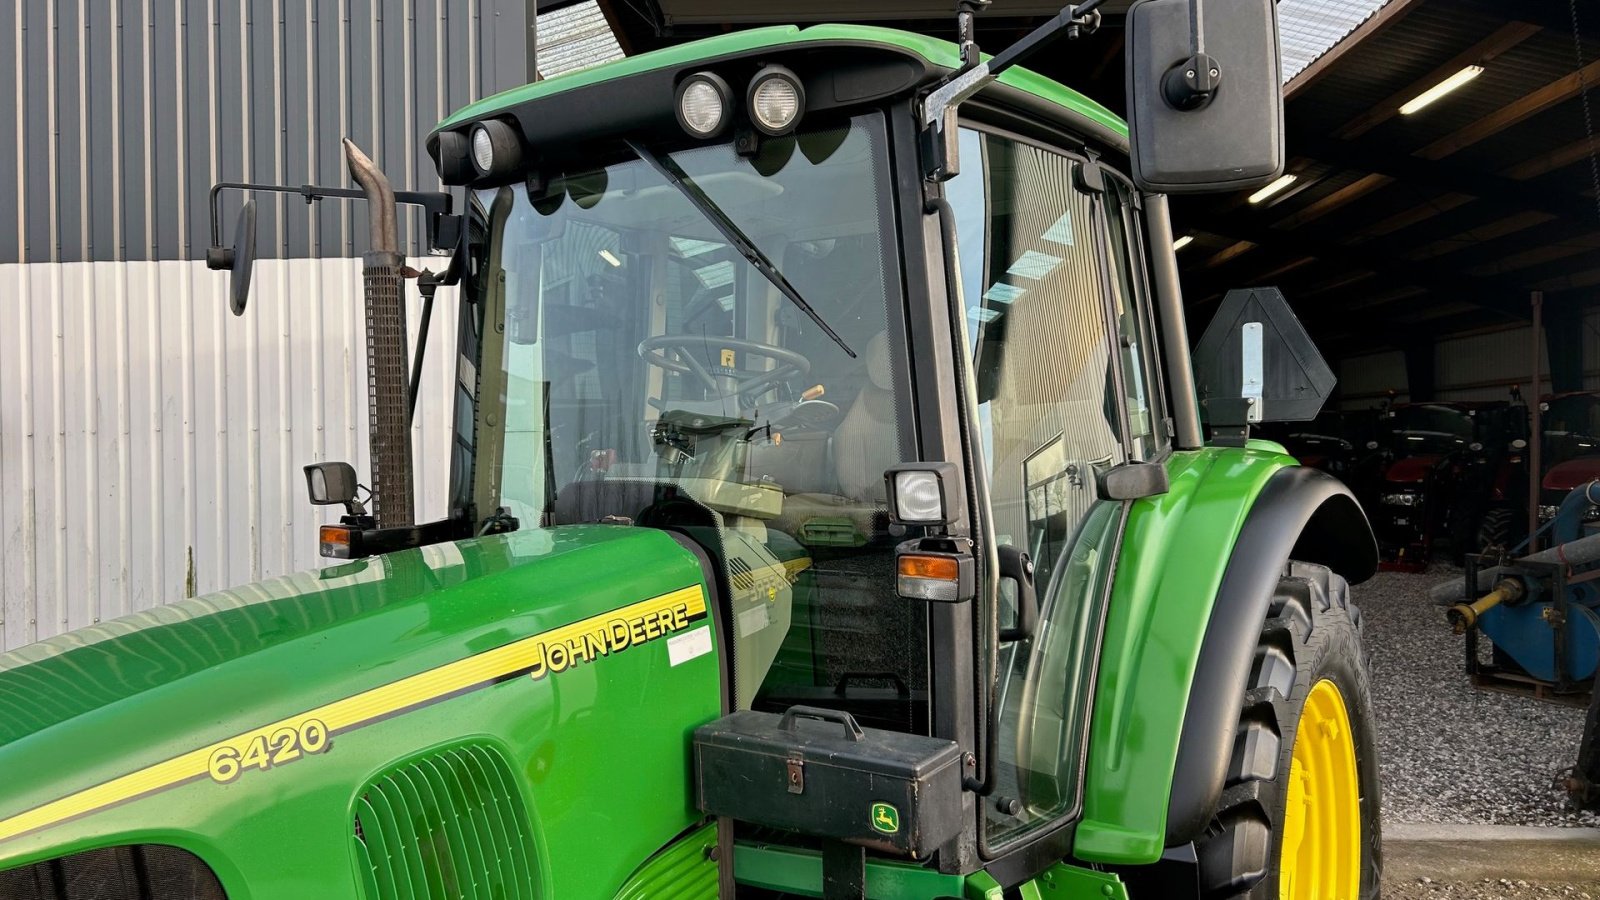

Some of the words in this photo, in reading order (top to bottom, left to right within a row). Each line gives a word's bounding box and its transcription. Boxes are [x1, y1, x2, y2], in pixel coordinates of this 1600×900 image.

[531, 629, 609, 680] JOHN
[607, 603, 690, 653] DEERE
[208, 718, 329, 784] 6420
